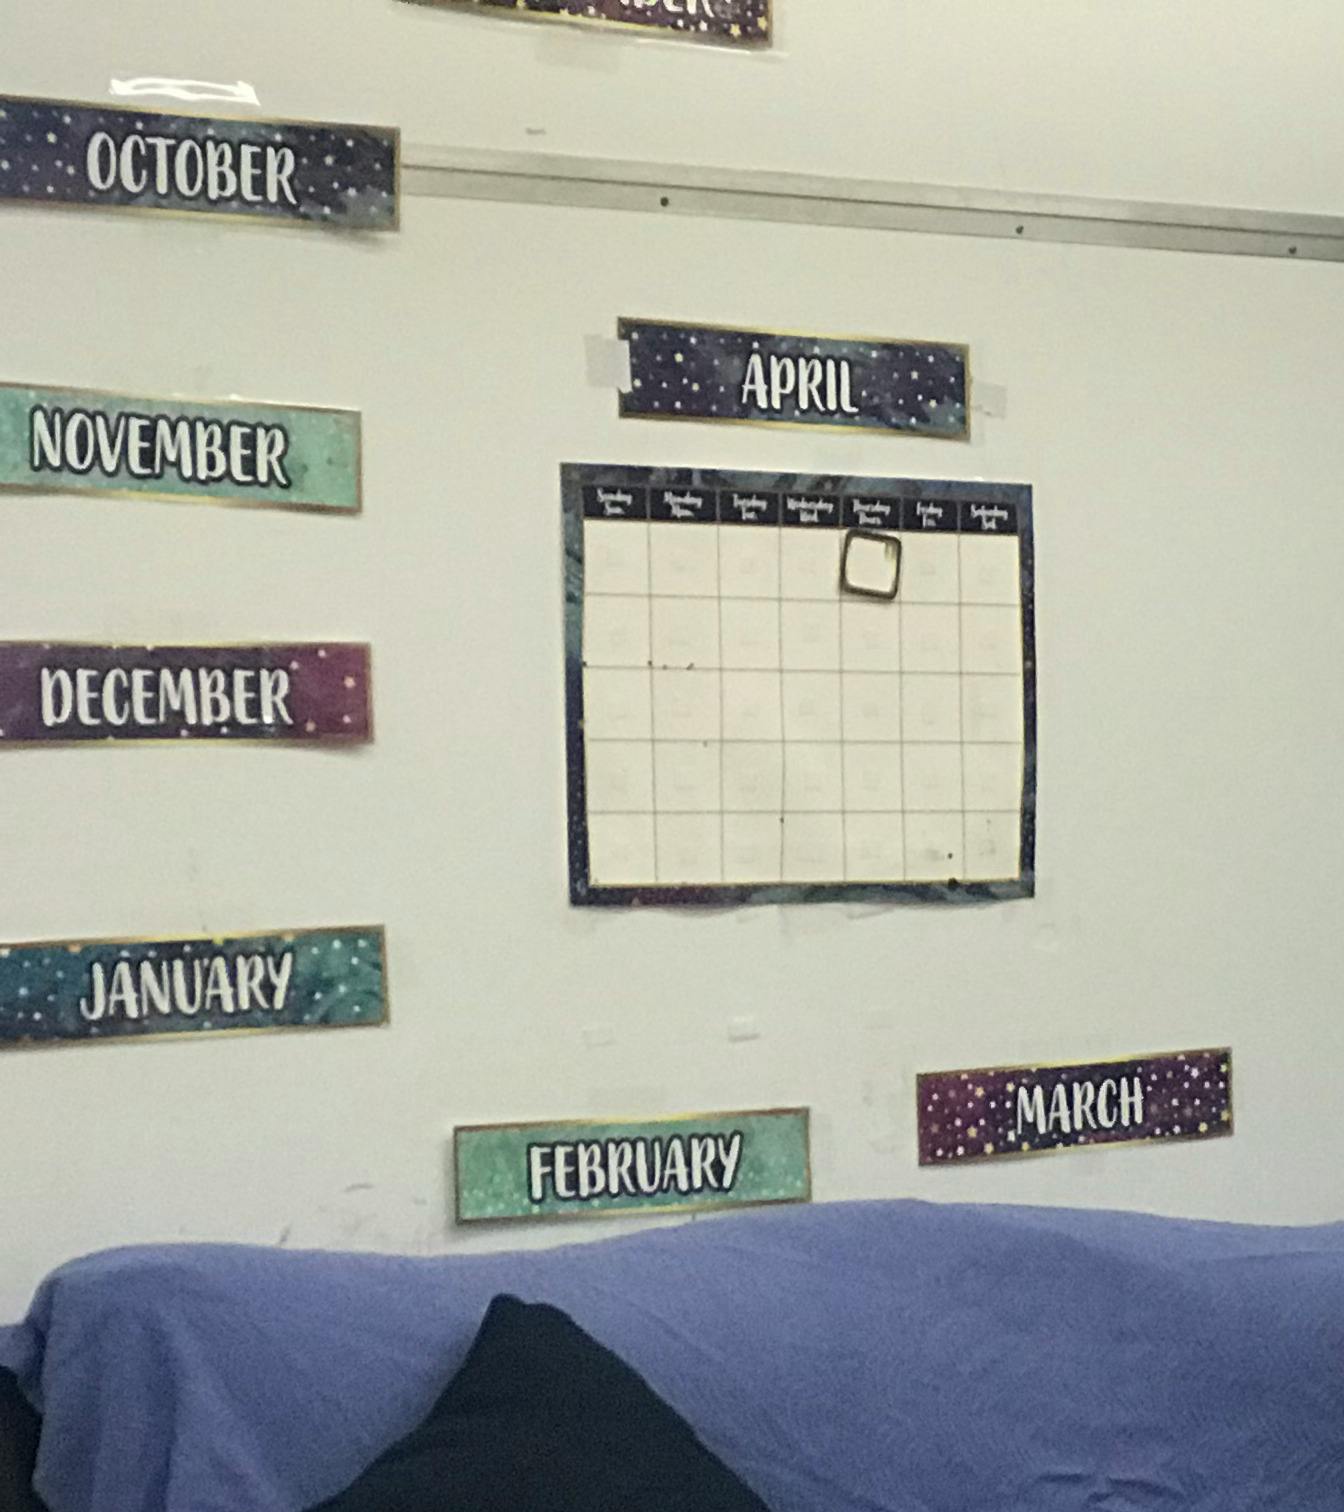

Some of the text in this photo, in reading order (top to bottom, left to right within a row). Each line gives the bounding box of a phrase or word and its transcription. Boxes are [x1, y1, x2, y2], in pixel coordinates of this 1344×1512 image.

[85, 131, 298, 206] OCTOBER
[741, 353, 860, 414] APRIL
[31, 410, 290, 487] NOVEMBER
[40, 666, 293, 728] DECEMBER
[79, 951, 293, 1021] JANUARY
[1016, 1075, 1145, 1136] MARCH
[528, 1133, 742, 1200] FEBRUARY
